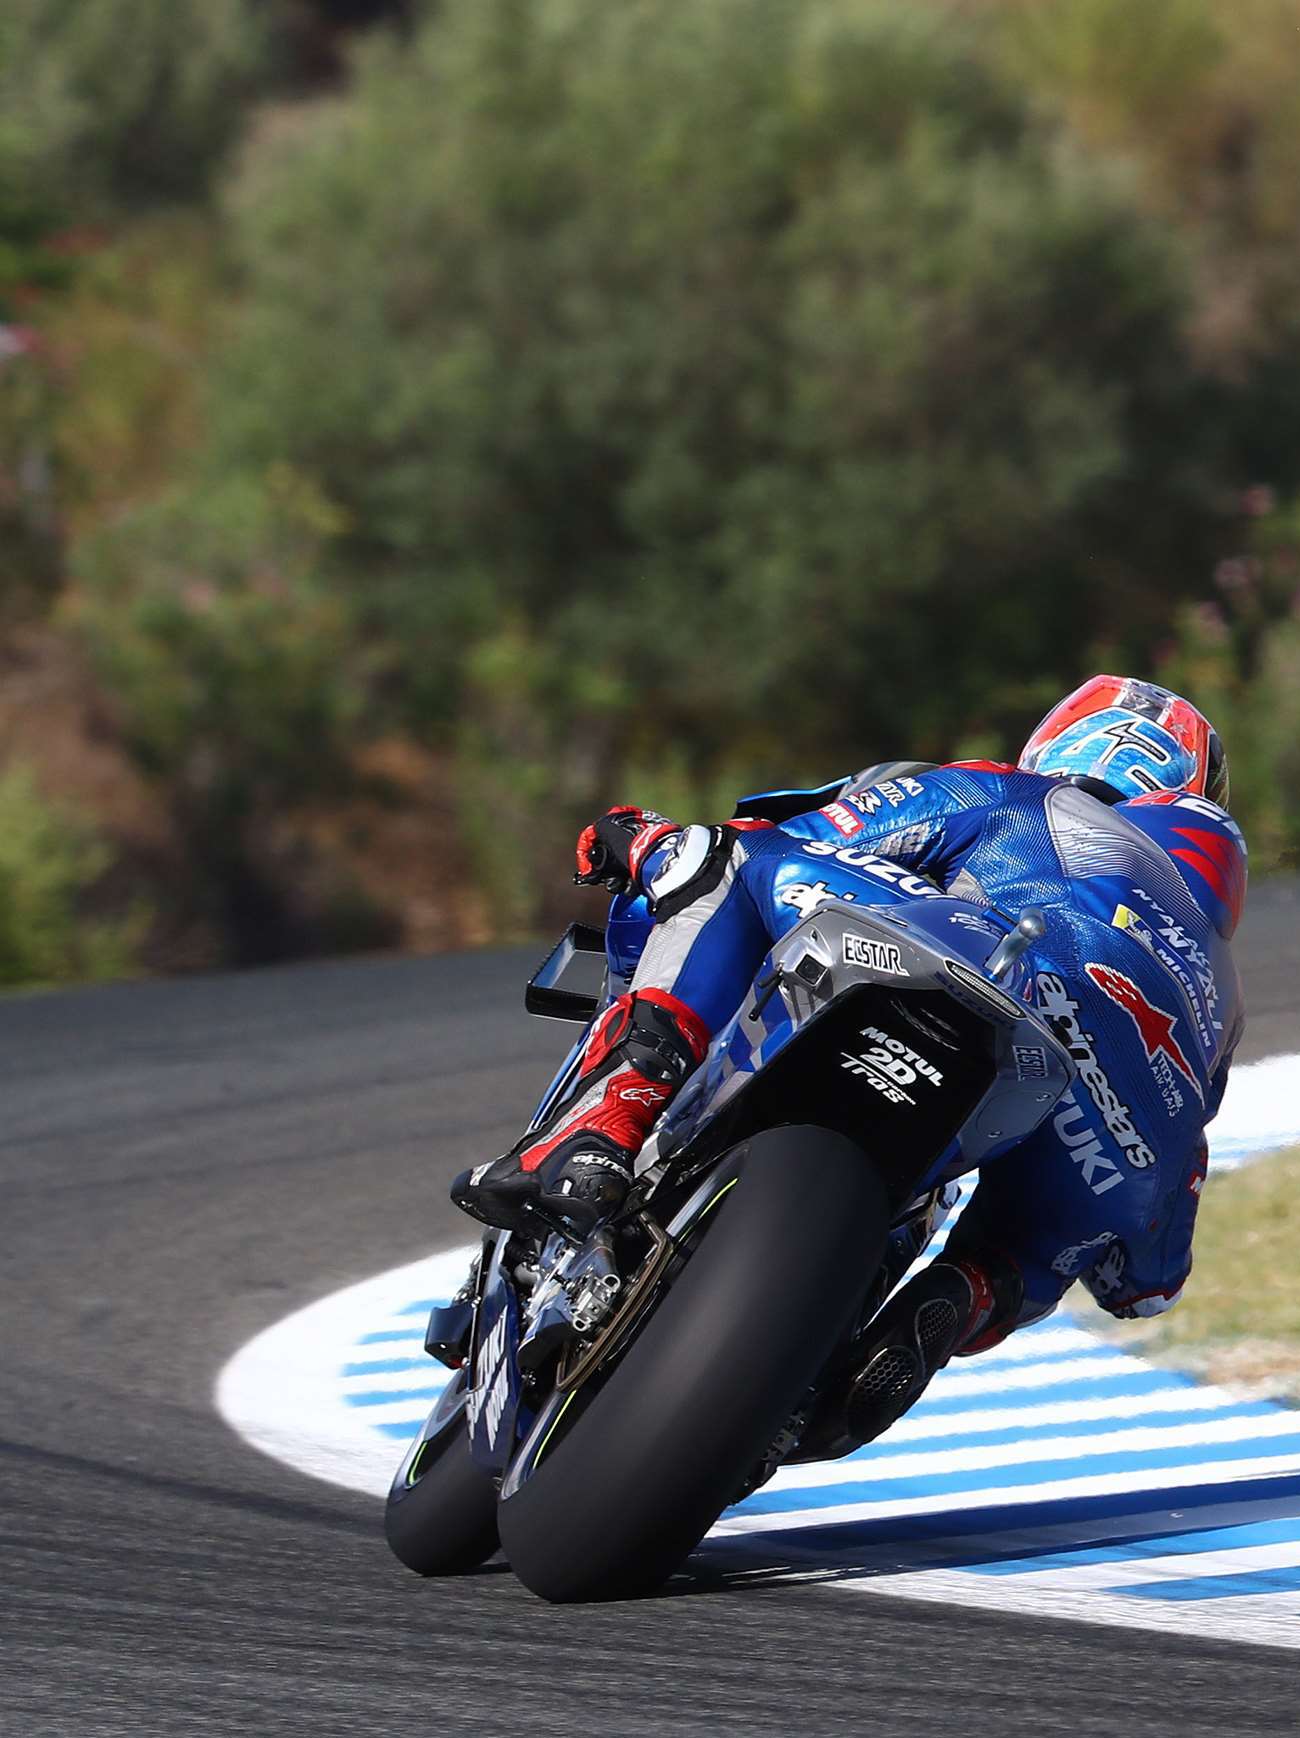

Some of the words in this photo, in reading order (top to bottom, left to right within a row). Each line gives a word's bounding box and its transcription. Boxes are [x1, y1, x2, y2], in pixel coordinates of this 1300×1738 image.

[802, 840, 959, 900] SUZU
[842, 933, 910, 977] ECSTAR
[1157, 949, 1211, 1048] MICHELIN
[860, 1026, 943, 1086] MOTUL
[1037, 972, 1156, 1169] alpinestars
[1051, 1091, 1124, 1195] UKI
